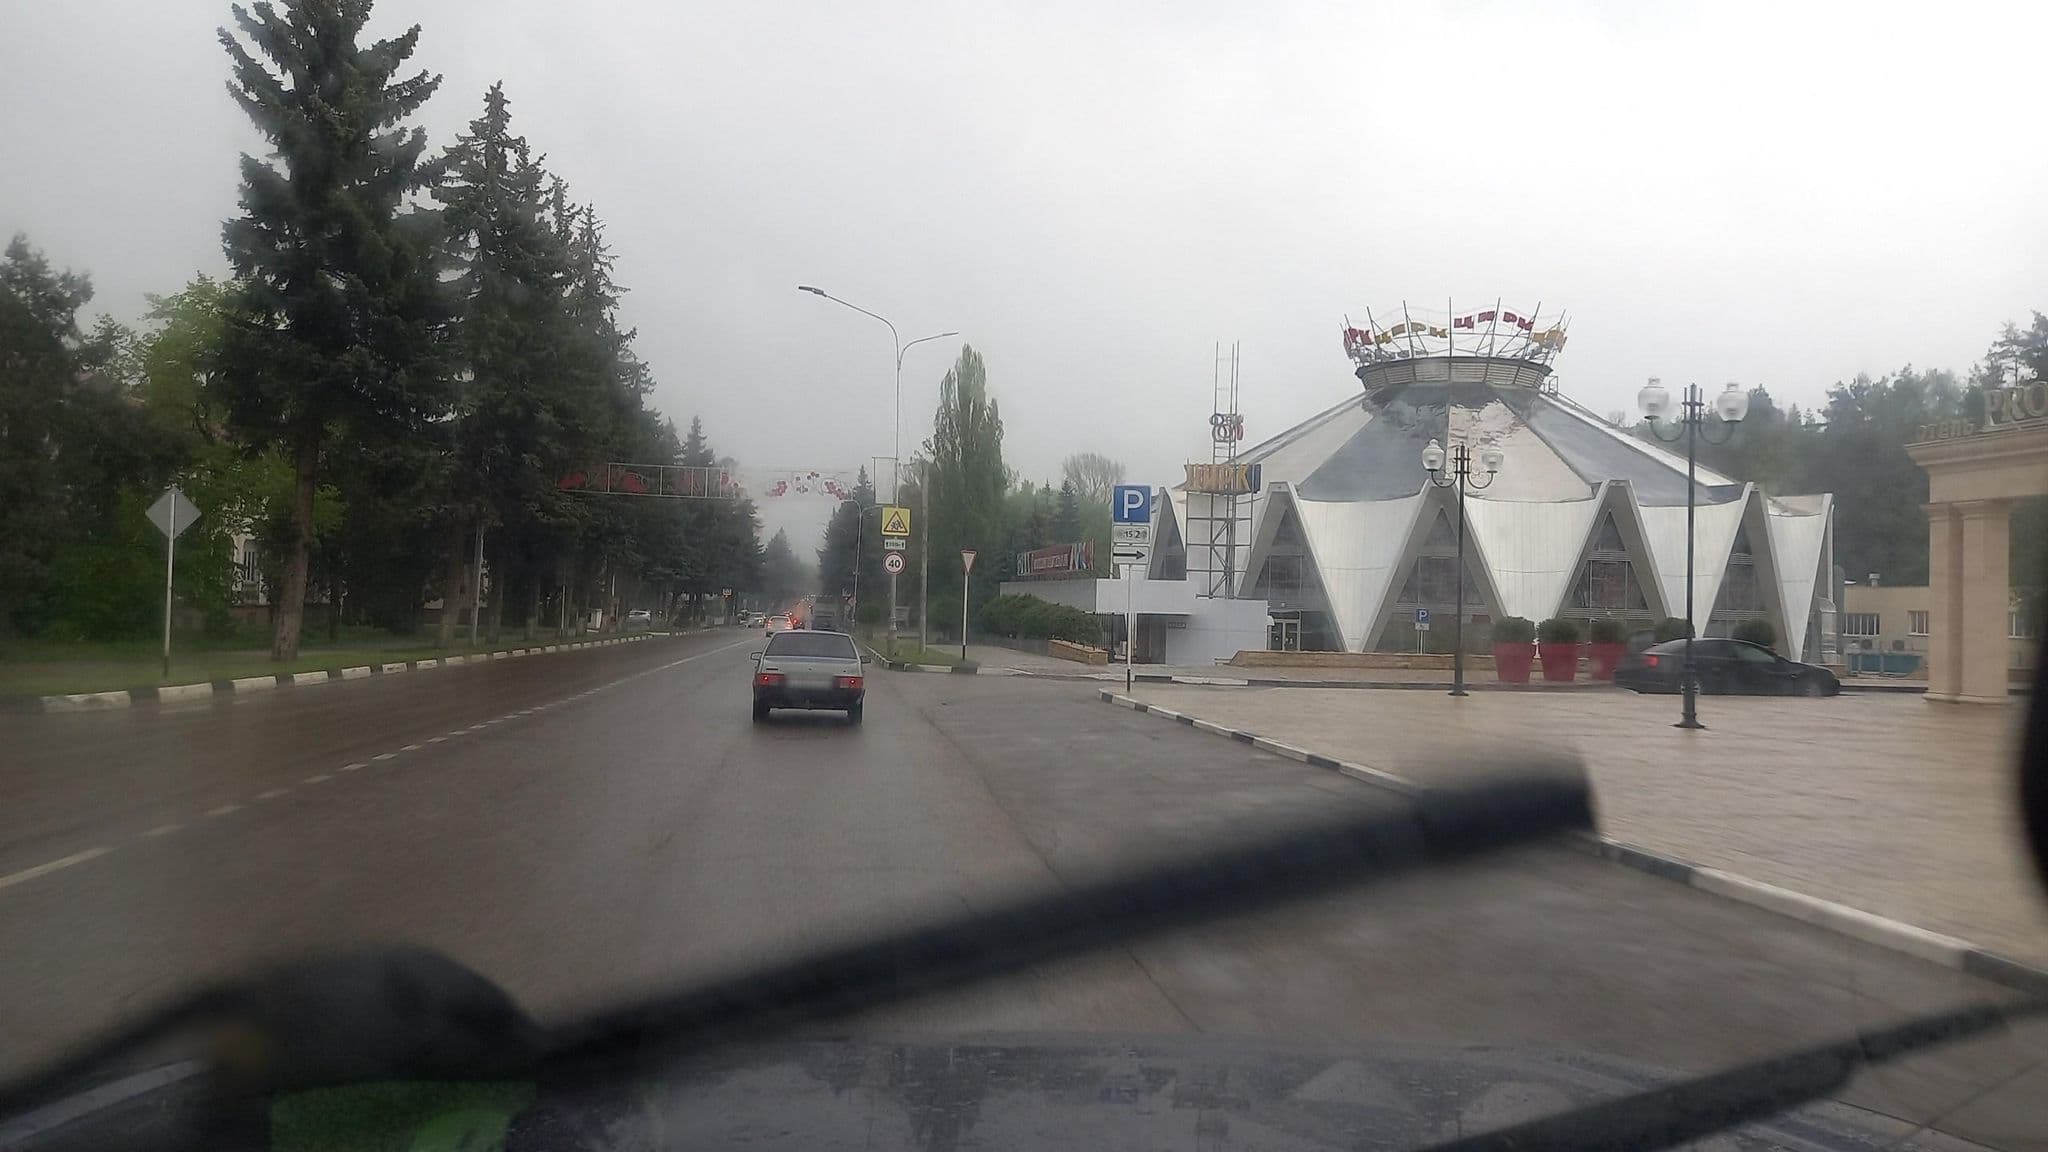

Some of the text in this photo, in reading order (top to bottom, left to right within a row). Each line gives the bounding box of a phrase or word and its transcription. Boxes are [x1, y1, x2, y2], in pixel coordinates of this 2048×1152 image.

[1454, 310, 1535, 331] ЦИРК
[1124, 490, 1144, 518] P
[889, 559, 901, 568] 40
[1419, 610, 1428, 621] P
